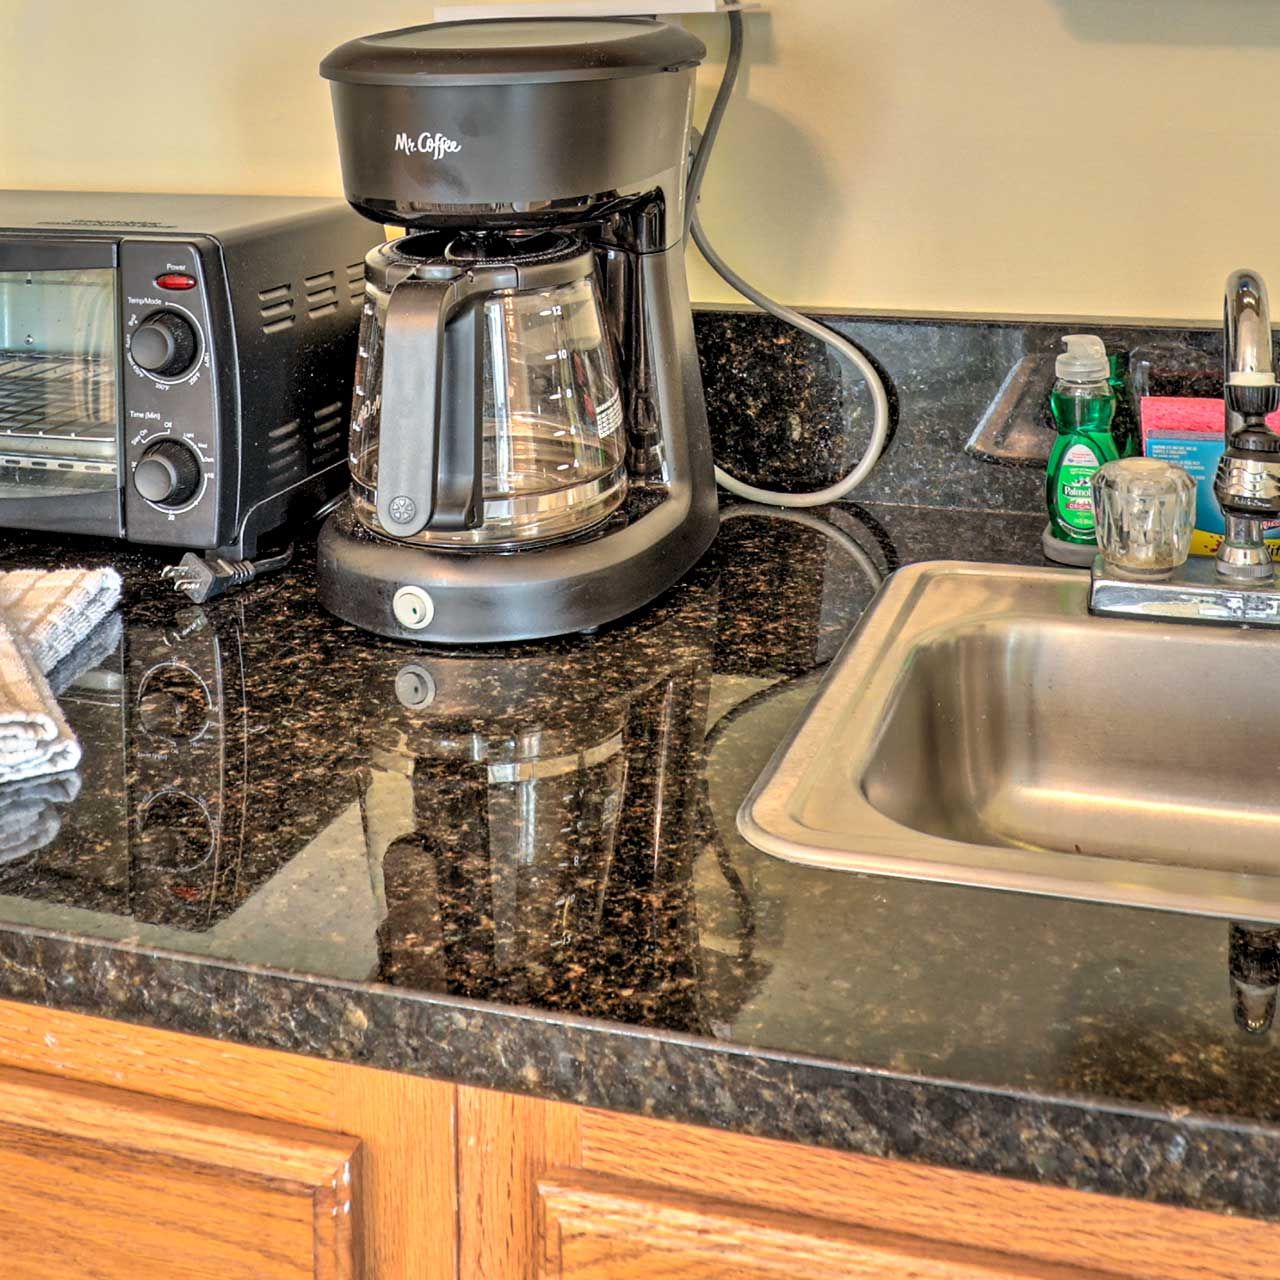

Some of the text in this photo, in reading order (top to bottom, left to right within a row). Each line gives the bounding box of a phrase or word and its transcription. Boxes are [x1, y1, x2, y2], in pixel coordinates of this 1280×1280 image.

[395, 131, 462, 160] Mr. Coffee
[166, 263, 186, 271] Power
[128, 296, 162, 307] Temp/Mode
[552, 306, 562, 316] 12
[558, 349, 567, 359] 10
[566, 388, 572, 398] 8
[130, 410, 161, 420] Time (Min)
